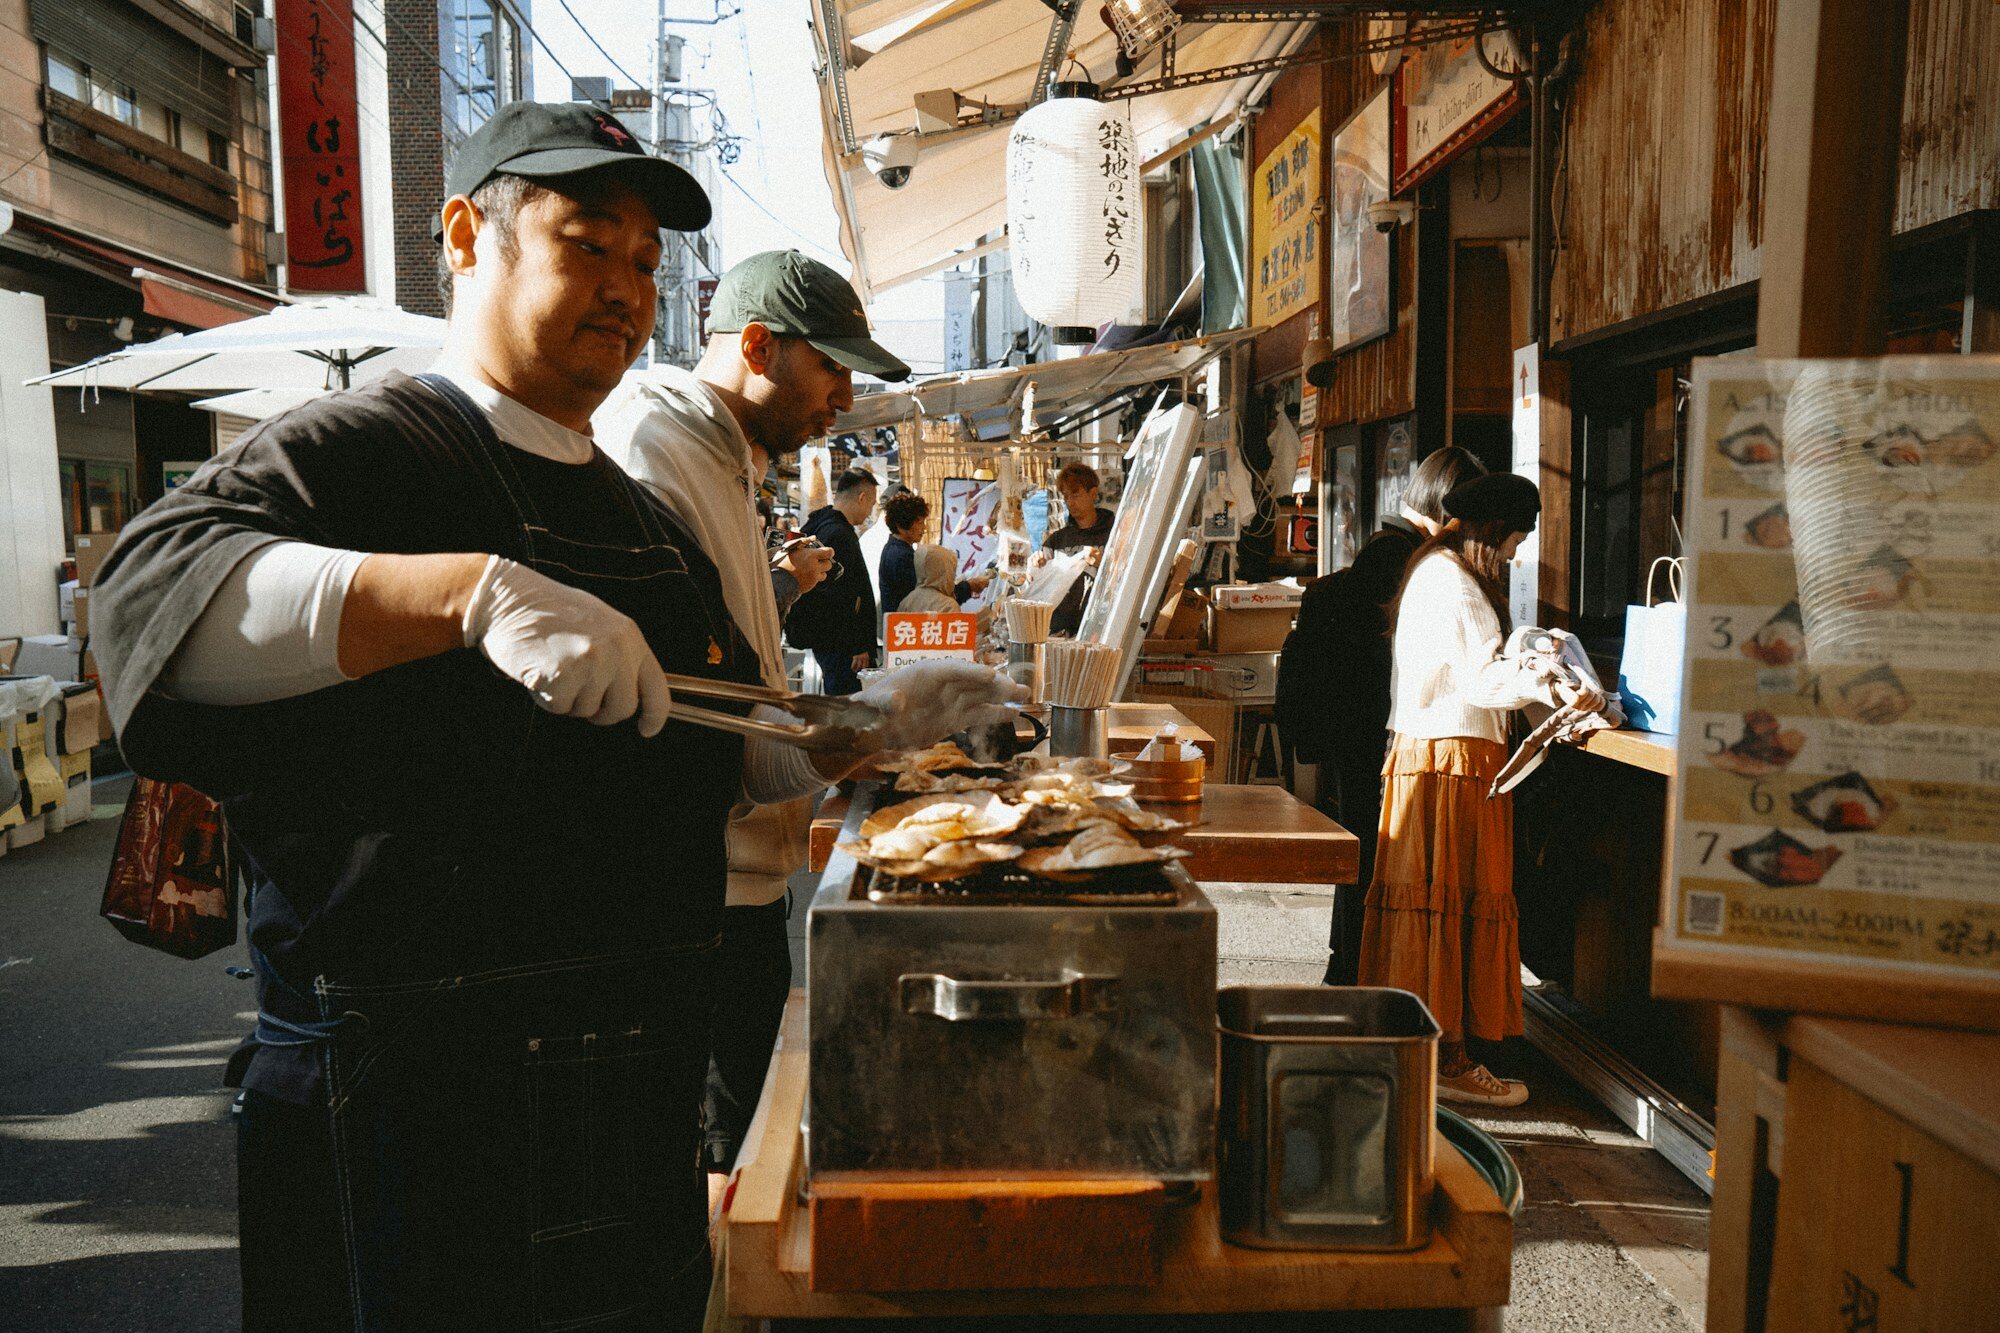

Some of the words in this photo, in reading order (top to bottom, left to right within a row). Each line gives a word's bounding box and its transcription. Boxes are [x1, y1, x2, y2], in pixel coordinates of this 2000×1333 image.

[1099, 120, 1129, 283] 築地のにぎり
[1719, 508, 1730, 540] 1
[893, 620, 969, 646] 免税店
[1710, 616, 1733, 649] 3
[1704, 722, 1727, 753] 5
[1750, 778, 1774, 815] 6
[1695, 831, 1719, 864] 7
